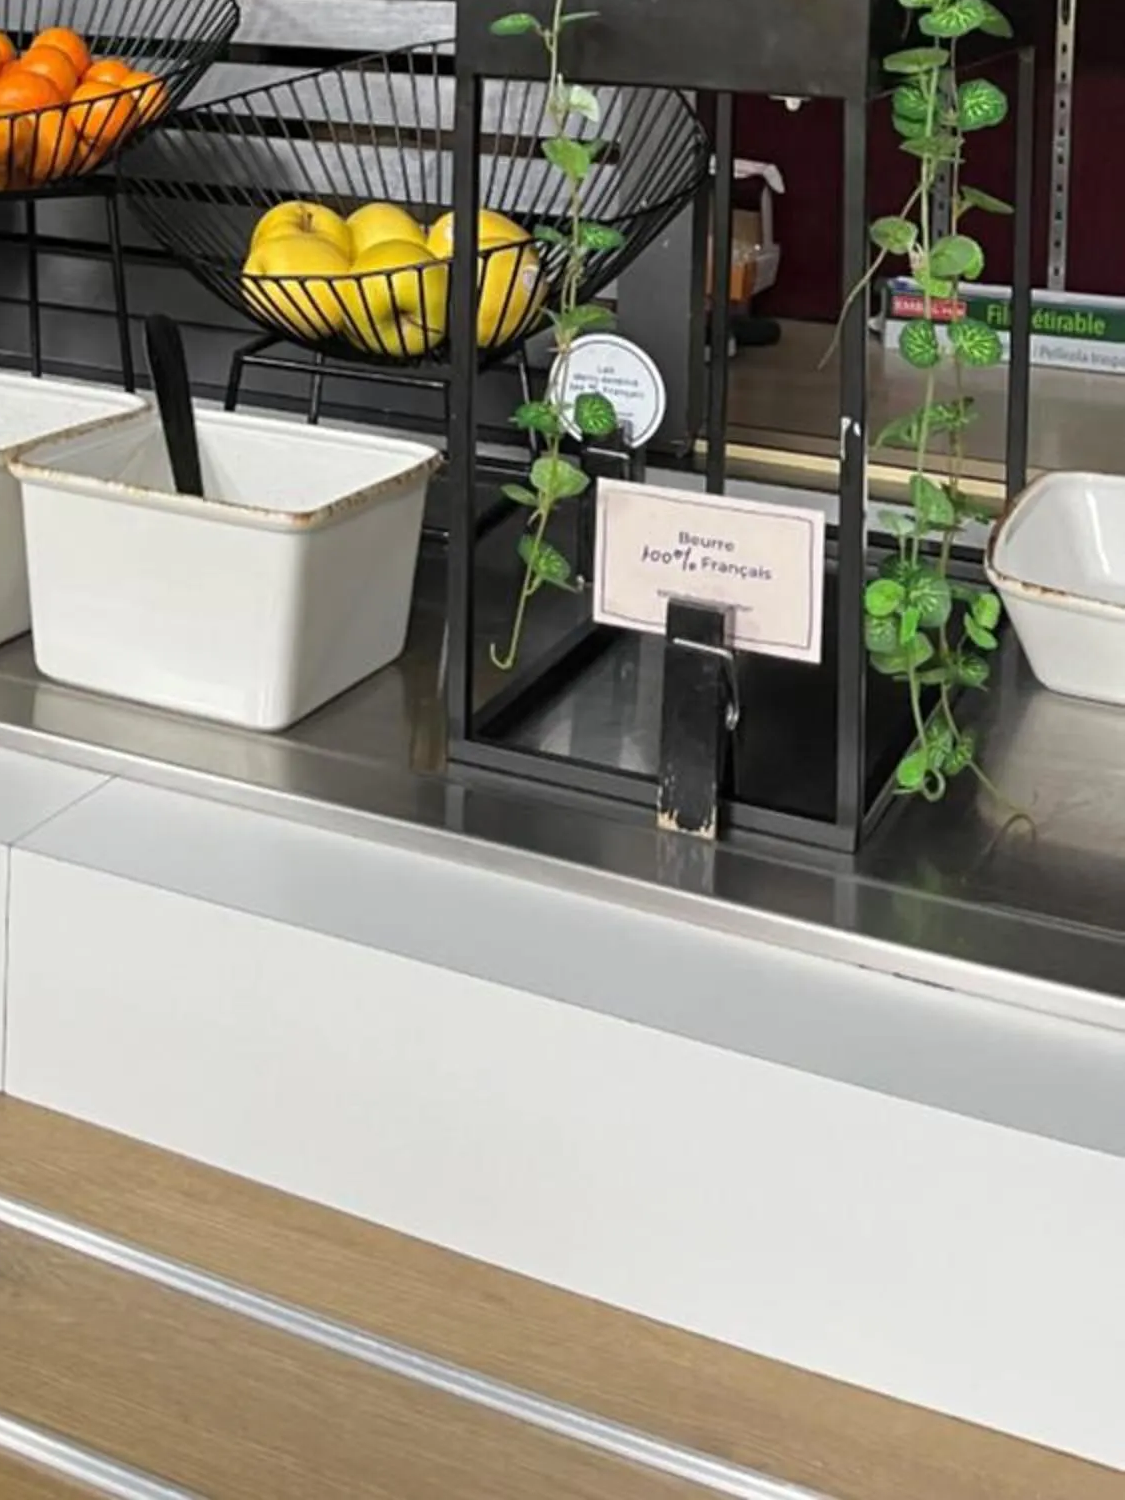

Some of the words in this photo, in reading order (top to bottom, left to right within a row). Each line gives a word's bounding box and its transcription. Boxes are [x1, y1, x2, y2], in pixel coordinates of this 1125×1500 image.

[986, 302, 1013, 326] Fil
[1031, 308, 1106, 336] étirable
[678, 531, 735, 552] Beurre
[701, 556, 773, 580] Français
